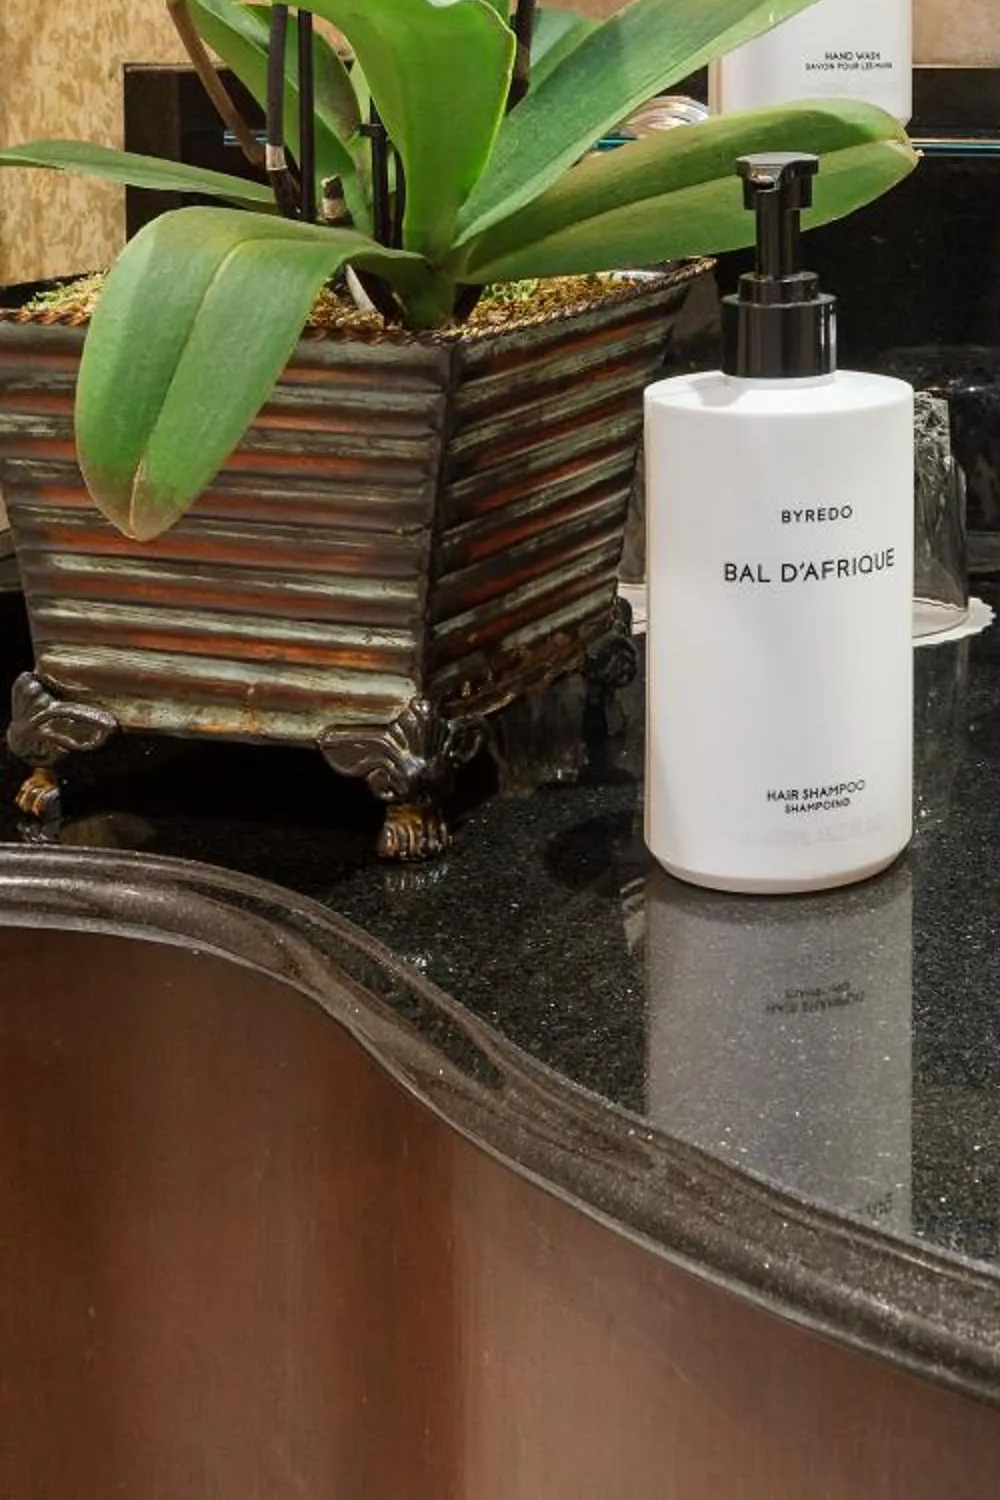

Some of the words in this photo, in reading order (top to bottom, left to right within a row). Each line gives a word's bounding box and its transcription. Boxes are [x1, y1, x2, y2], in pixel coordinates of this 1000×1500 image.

[825, 51, 854, 61] HAND
[781, 505, 853, 524] BYREDO
[724, 563, 771, 583] BAL
[781, 548, 895, 583] D'AFRIQUE
[767, 789, 799, 802] HAIR
[801, 779, 866, 801] SHAMPOO
[784, 797, 851, 814] SHAMPOING
